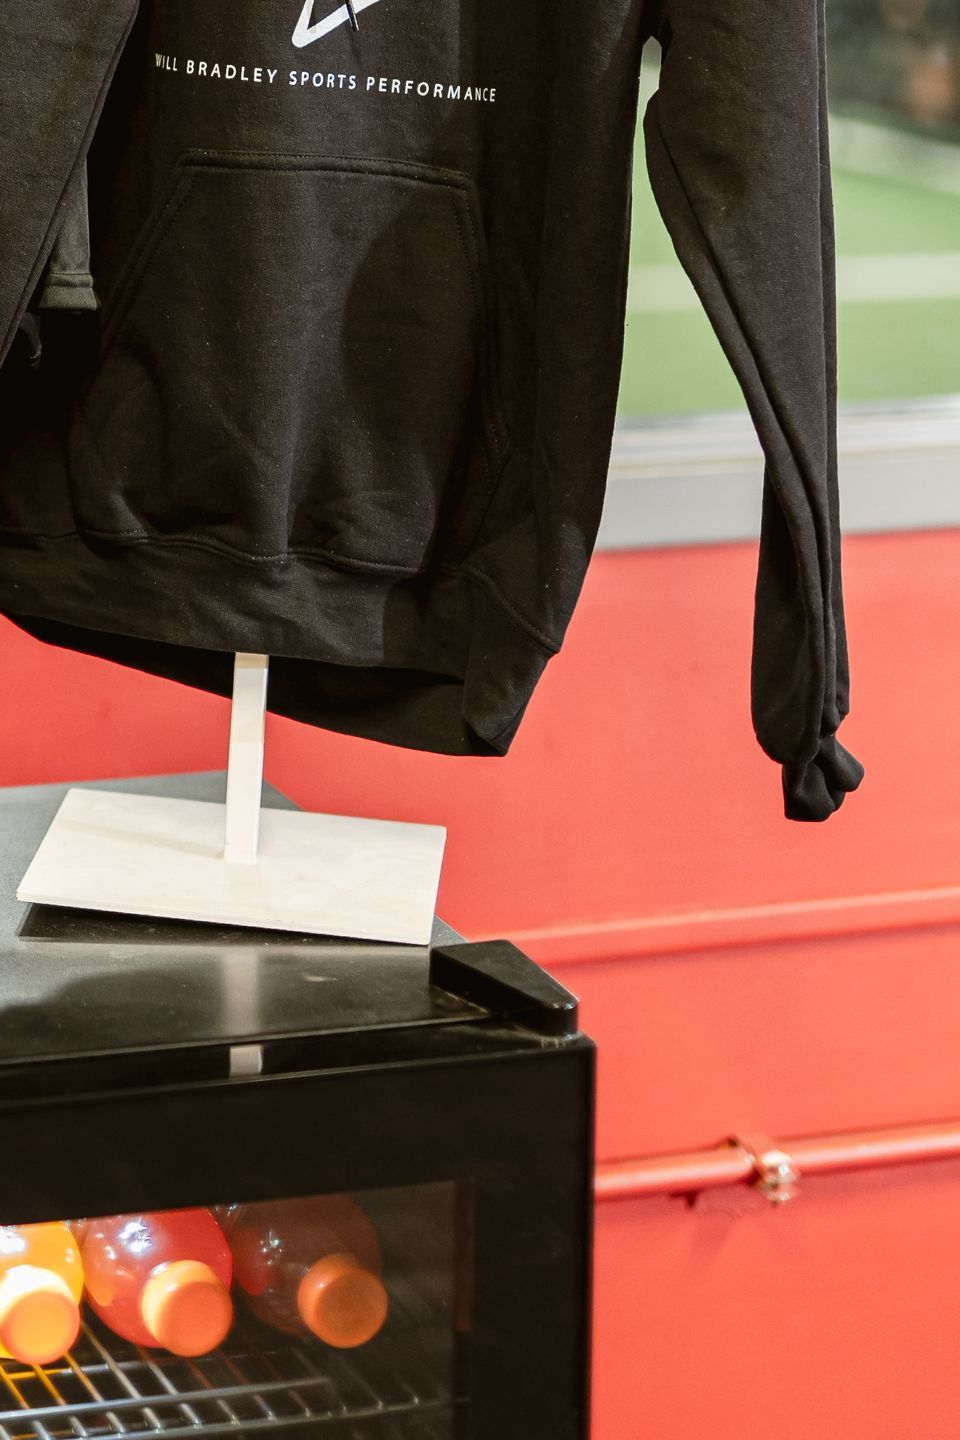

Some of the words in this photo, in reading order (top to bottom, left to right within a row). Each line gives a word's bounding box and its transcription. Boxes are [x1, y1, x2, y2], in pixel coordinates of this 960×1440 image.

[155, 53, 178, 72] WILL
[186, 59, 278, 84] BRADLEY
[288, 70, 357, 90] SPORTS
[366, 76, 497, 102] PERFORMANCE
